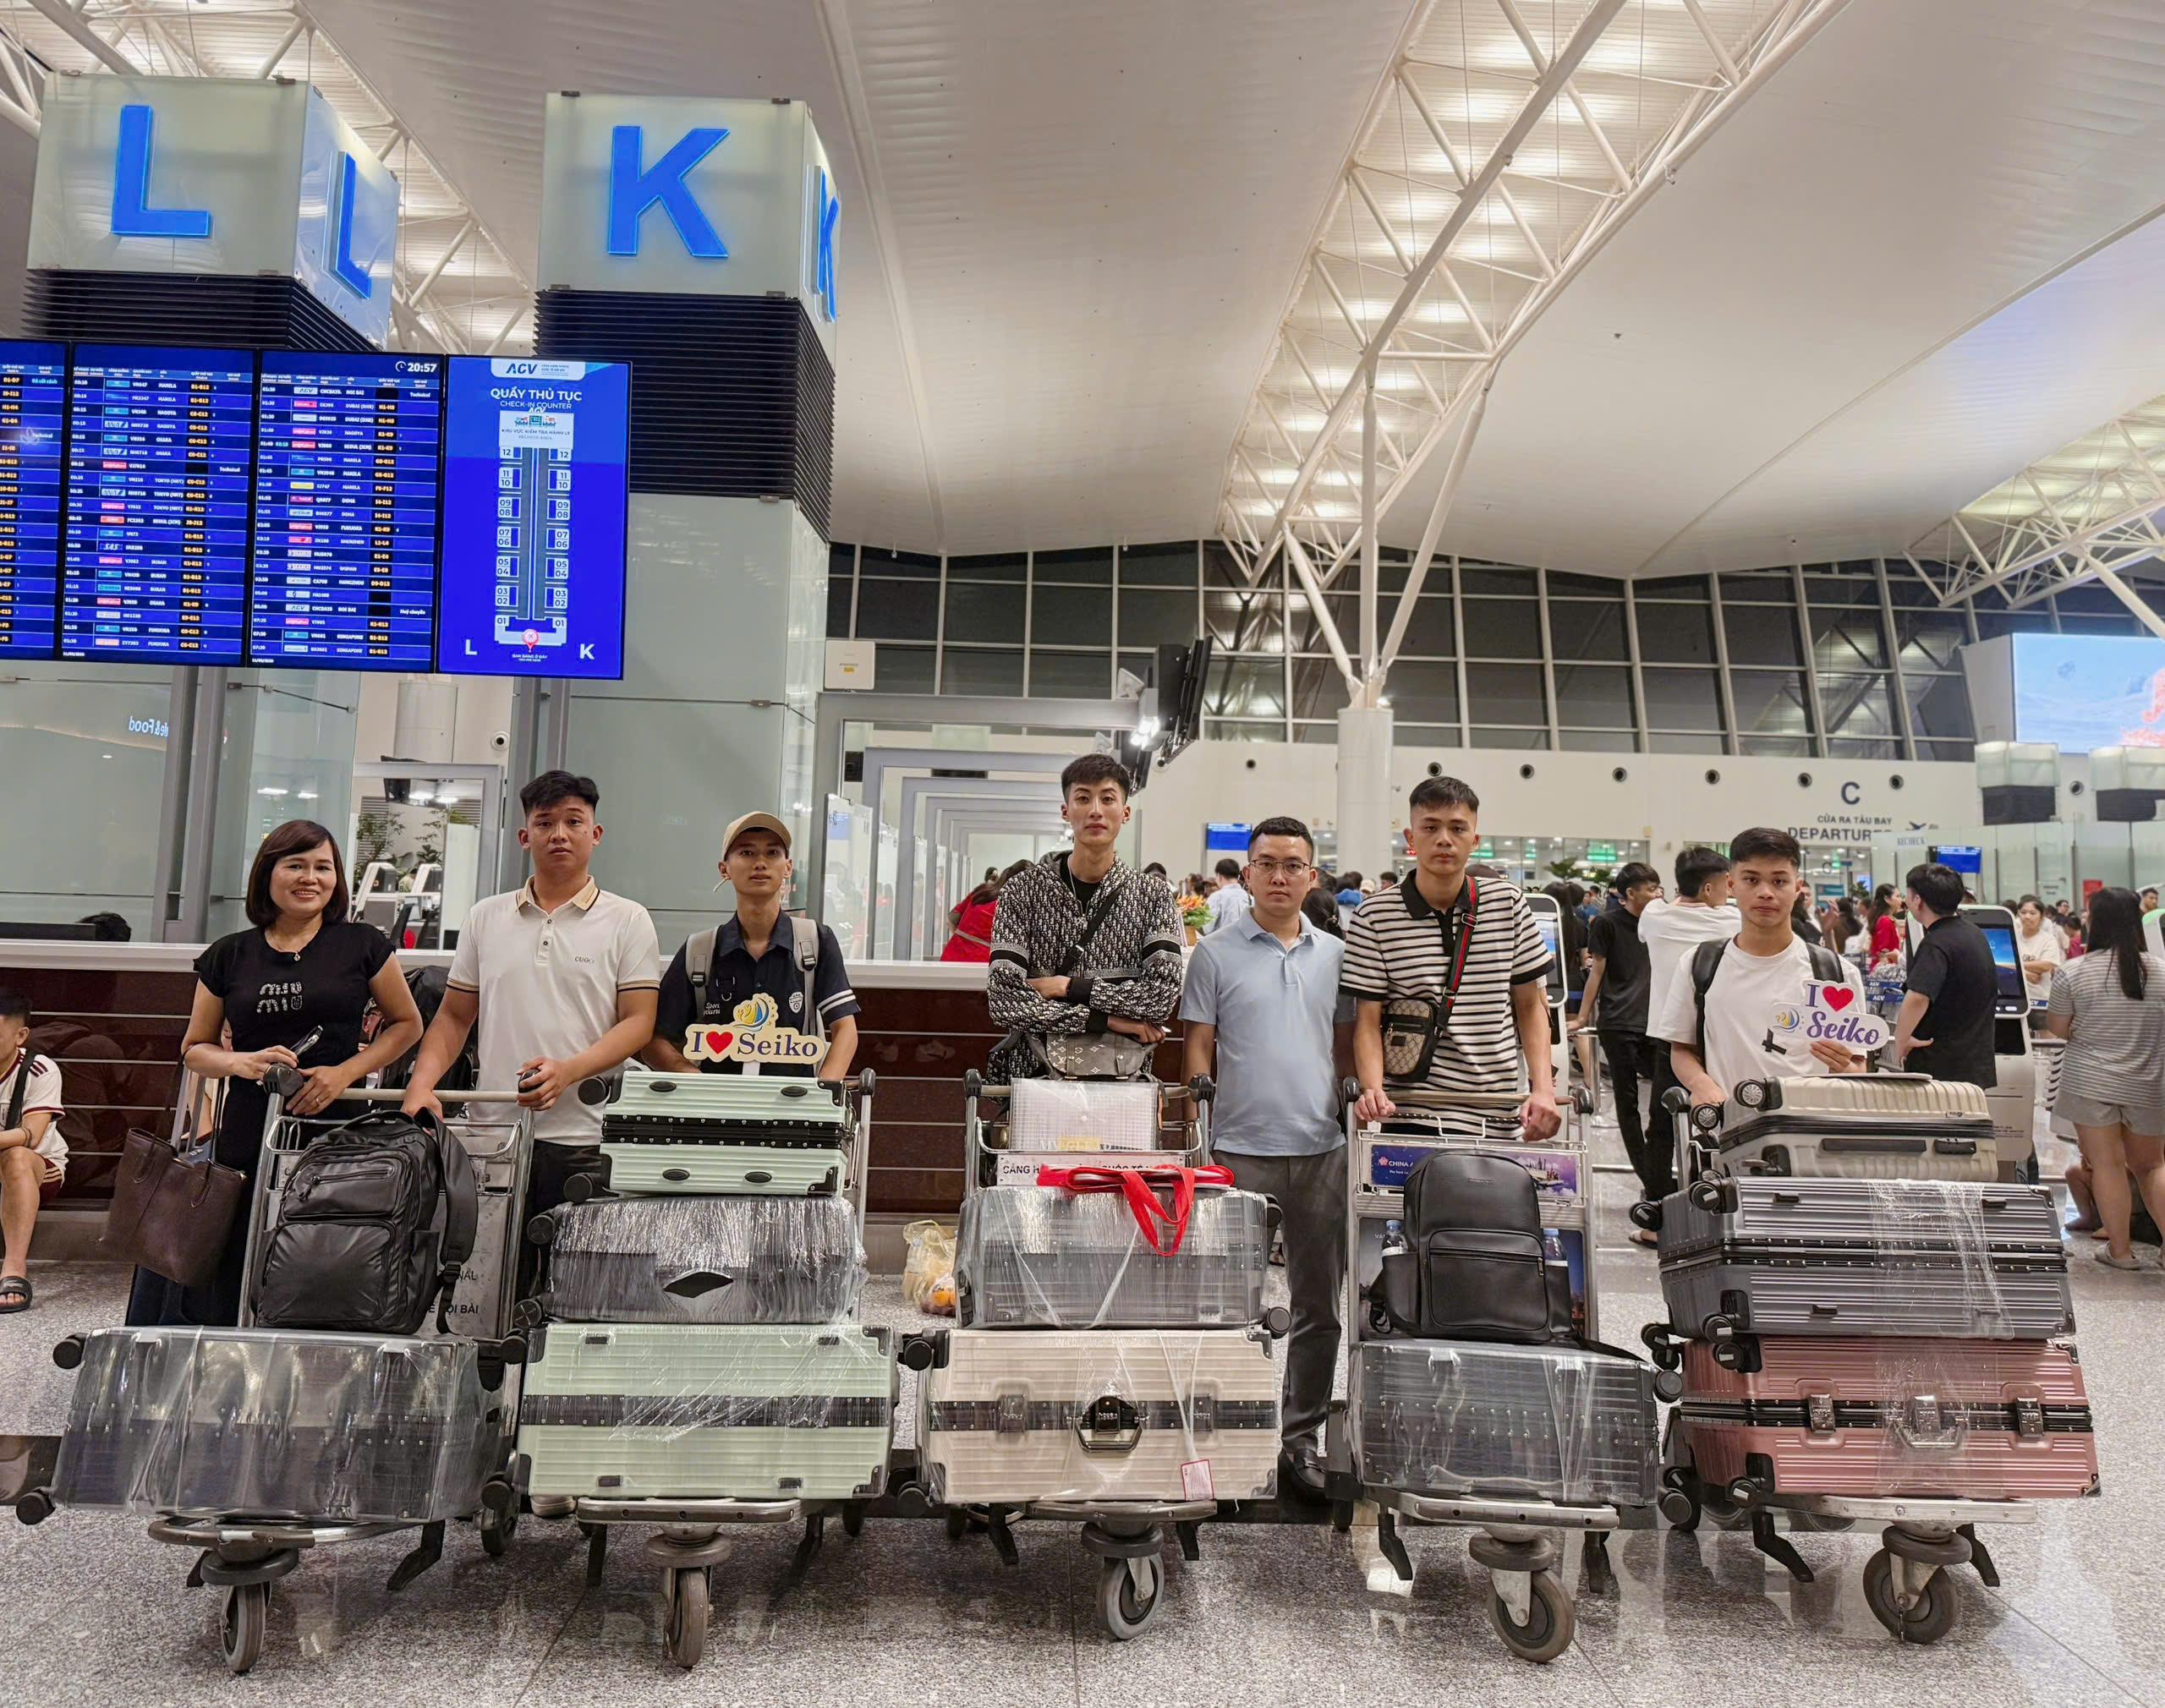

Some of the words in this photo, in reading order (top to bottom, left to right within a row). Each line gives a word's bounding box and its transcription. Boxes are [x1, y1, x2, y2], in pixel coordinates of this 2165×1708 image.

[112, 105, 210, 237] L
[608, 125, 730, 258] K
[336, 151, 371, 299] L
[817, 168, 839, 323] K
[408, 362, 437, 373] 20:57
[506, 363, 538, 375] ACV
[528, 387, 554, 400] THỦ
[556, 391, 582, 403] TỤC
[465, 638, 478, 655] L
[579, 643, 595, 660] K
[1841, 781, 1861, 805] C
[1817, 813, 1836, 824] CỬA
[1854, 815, 1872, 824] TÀU
[1874, 817, 1893, 825] BAY
[1788, 827, 1892, 841] DEPARTUR
[1805, 983, 1820, 1008] I
[1806, 1011, 1880, 1045] Seiko
[690, 1031, 704, 1053] I
[737, 1032, 818, 1057] Seiko
[1003, 1163, 1030, 1174] CẢNG
[460, 1303, 479, 1314] BÀI
